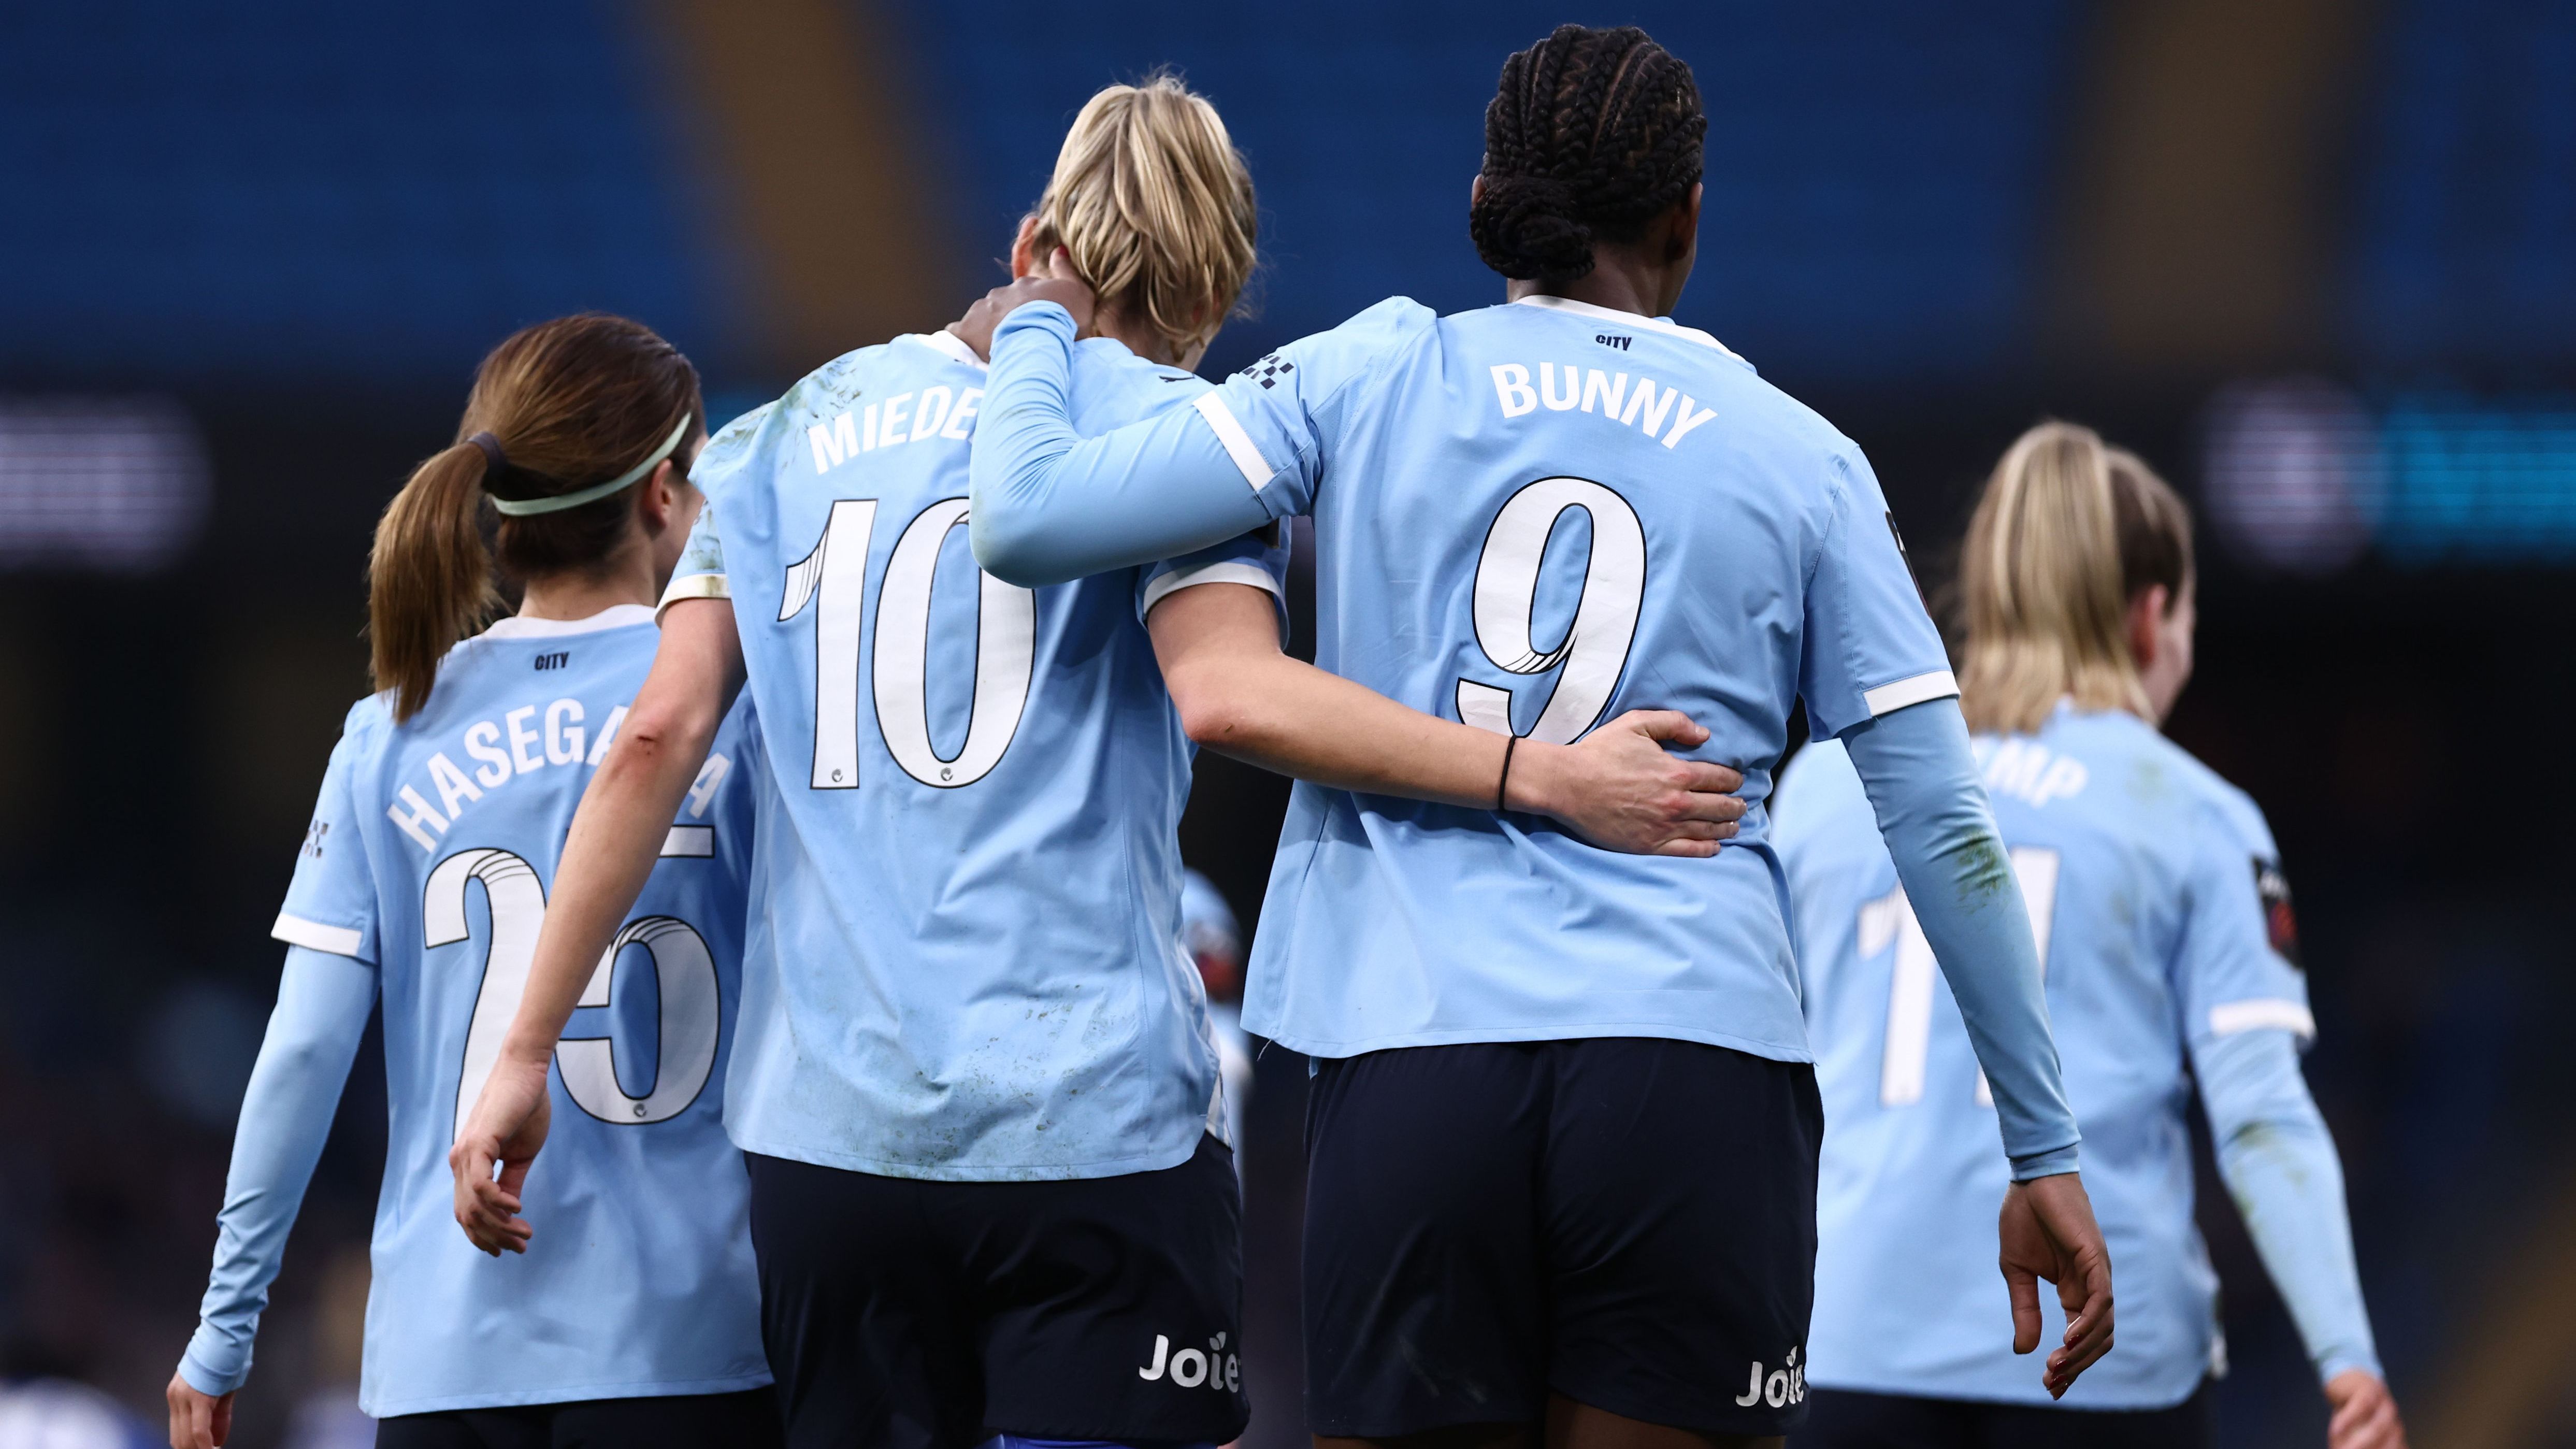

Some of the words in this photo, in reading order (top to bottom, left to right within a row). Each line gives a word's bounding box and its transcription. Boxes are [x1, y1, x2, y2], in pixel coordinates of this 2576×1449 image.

[1595, 334, 1632, 351] CITY
[1490, 362, 1718, 449] BUNNY
[777, 497, 1035, 790] 10
[1455, 476, 1647, 745] 9
[534, 651, 569, 670] CITY
[386, 698, 730, 854] HASEGAA
[1970, 738, 2089, 809] MP
[423, 825, 721, 1146] 25
[1139, 1331, 1239, 1393] Joie
[1736, 1345, 1804, 1408] Joie
